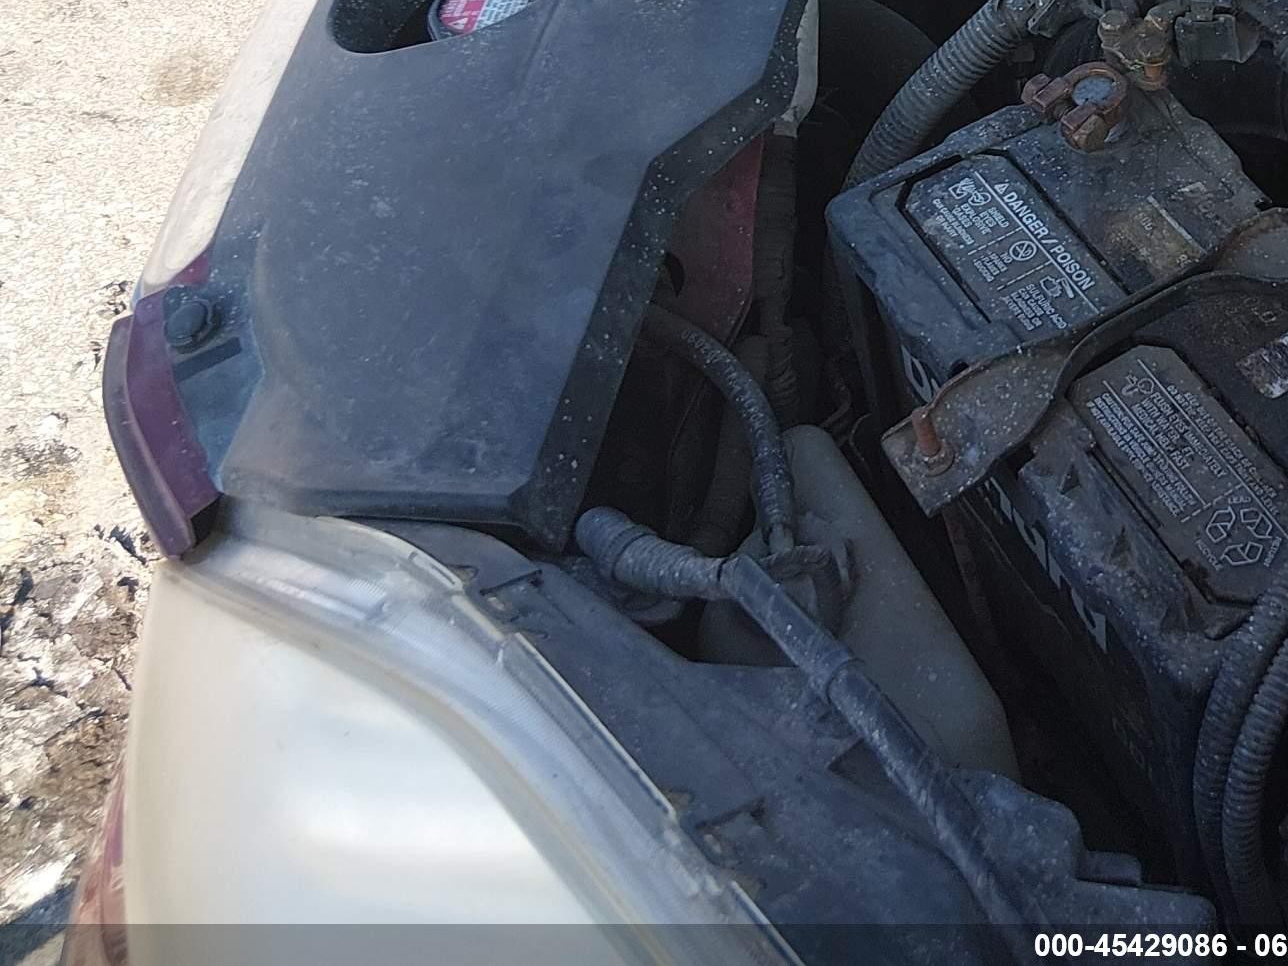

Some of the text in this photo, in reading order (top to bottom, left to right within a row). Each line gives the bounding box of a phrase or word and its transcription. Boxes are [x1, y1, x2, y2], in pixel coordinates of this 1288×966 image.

[952, 206, 972, 228] GASES
[979, 210, 997, 228] EYES
[987, 206, 1010, 229] SHIELD
[1002, 190, 1049, 238] DANGER
[1049, 243, 1095, 291] POISON
[999, 251, 1012, 264] NO
[1025, 282, 1067, 330] SULFURIC ACID
[1140, 397, 1160, 418] WITH
[1149, 391, 1174, 416] FLUSH
[1168, 413, 1189, 434] EYES
[1130, 403, 1160, 434] MEDICAL
[1169, 450, 1190, 470] FAST
